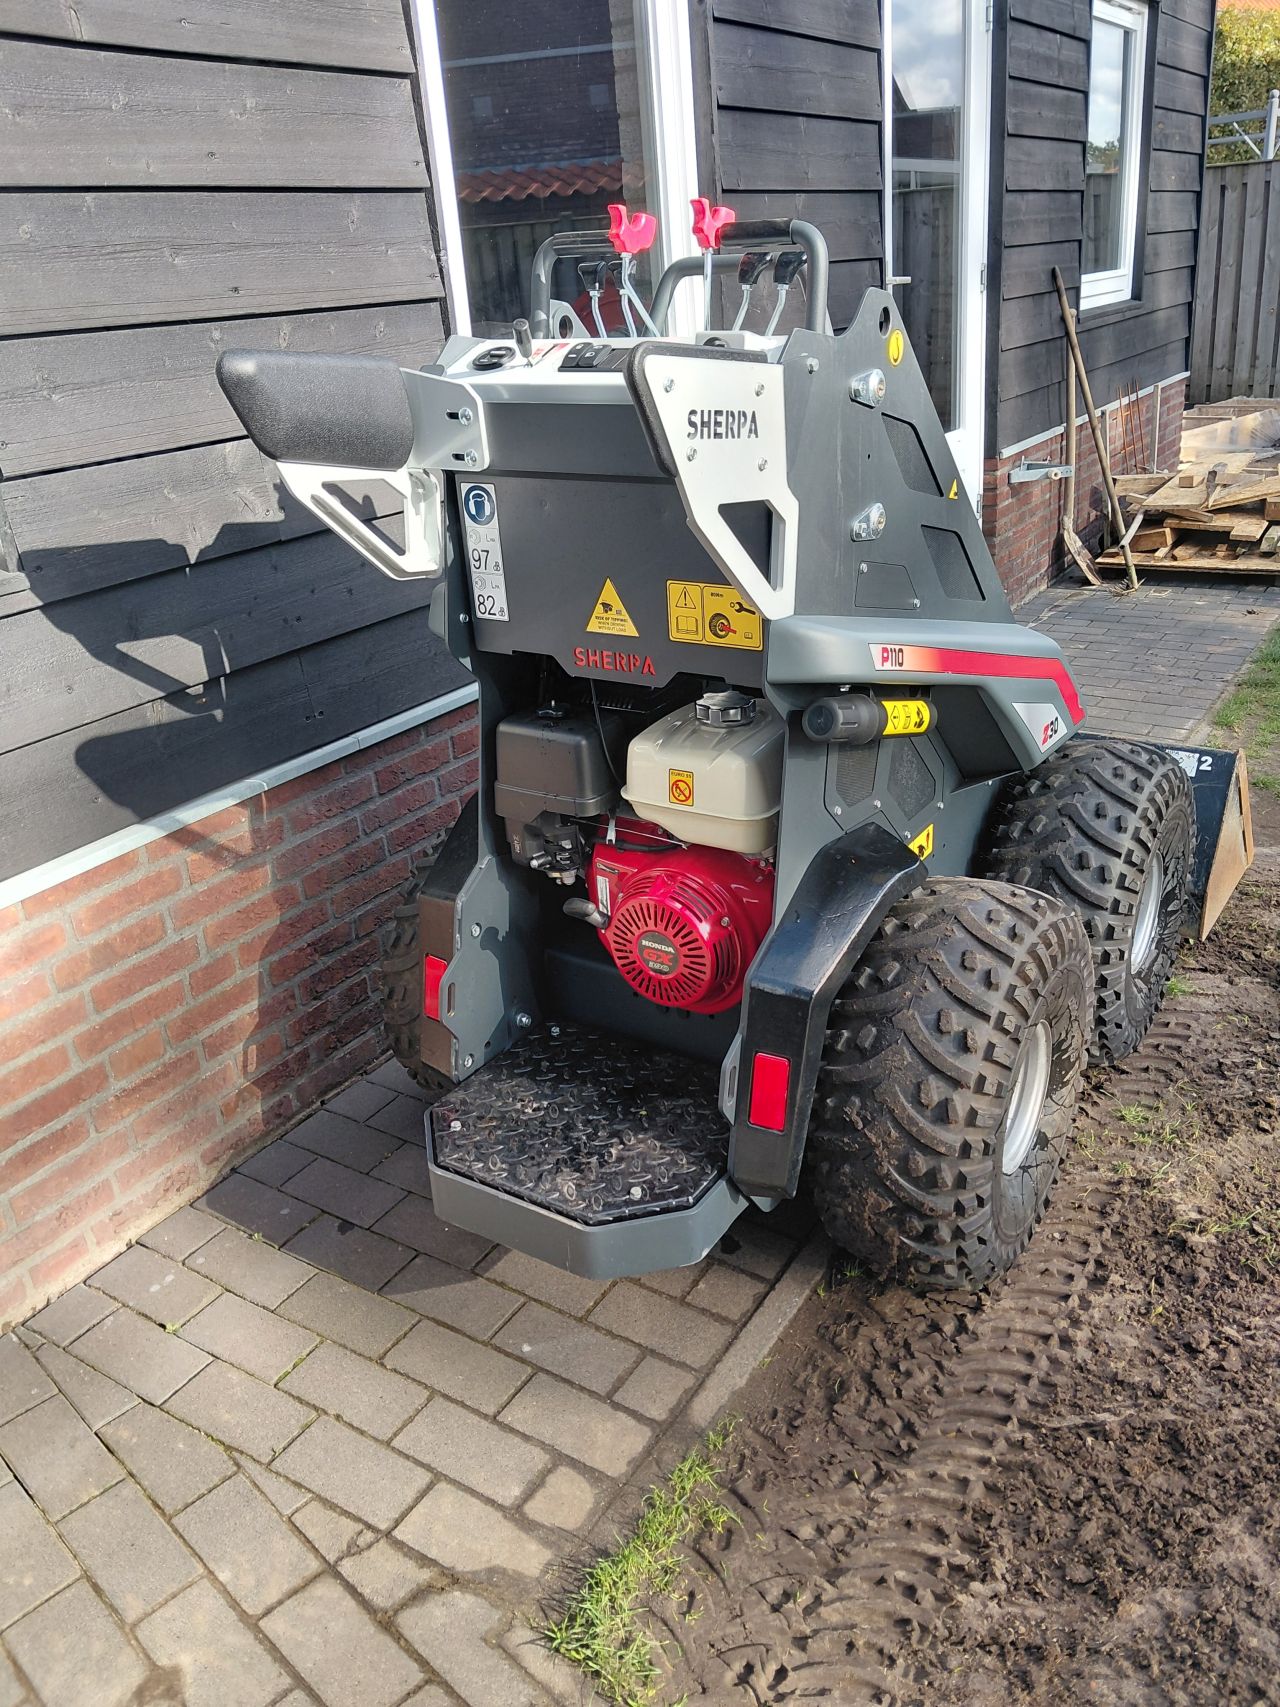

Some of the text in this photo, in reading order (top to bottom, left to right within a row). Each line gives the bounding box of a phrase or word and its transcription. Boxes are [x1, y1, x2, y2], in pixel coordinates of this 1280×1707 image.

[687, 409, 759, 440] SHERPA
[471, 548, 490, 571] 97
[477, 594, 497, 617] 82
[573, 647, 656, 676] SHERPA
[881, 646, 904, 668] P110
[641, 939, 676, 954] HONDA
[643, 948, 674, 966] GX
